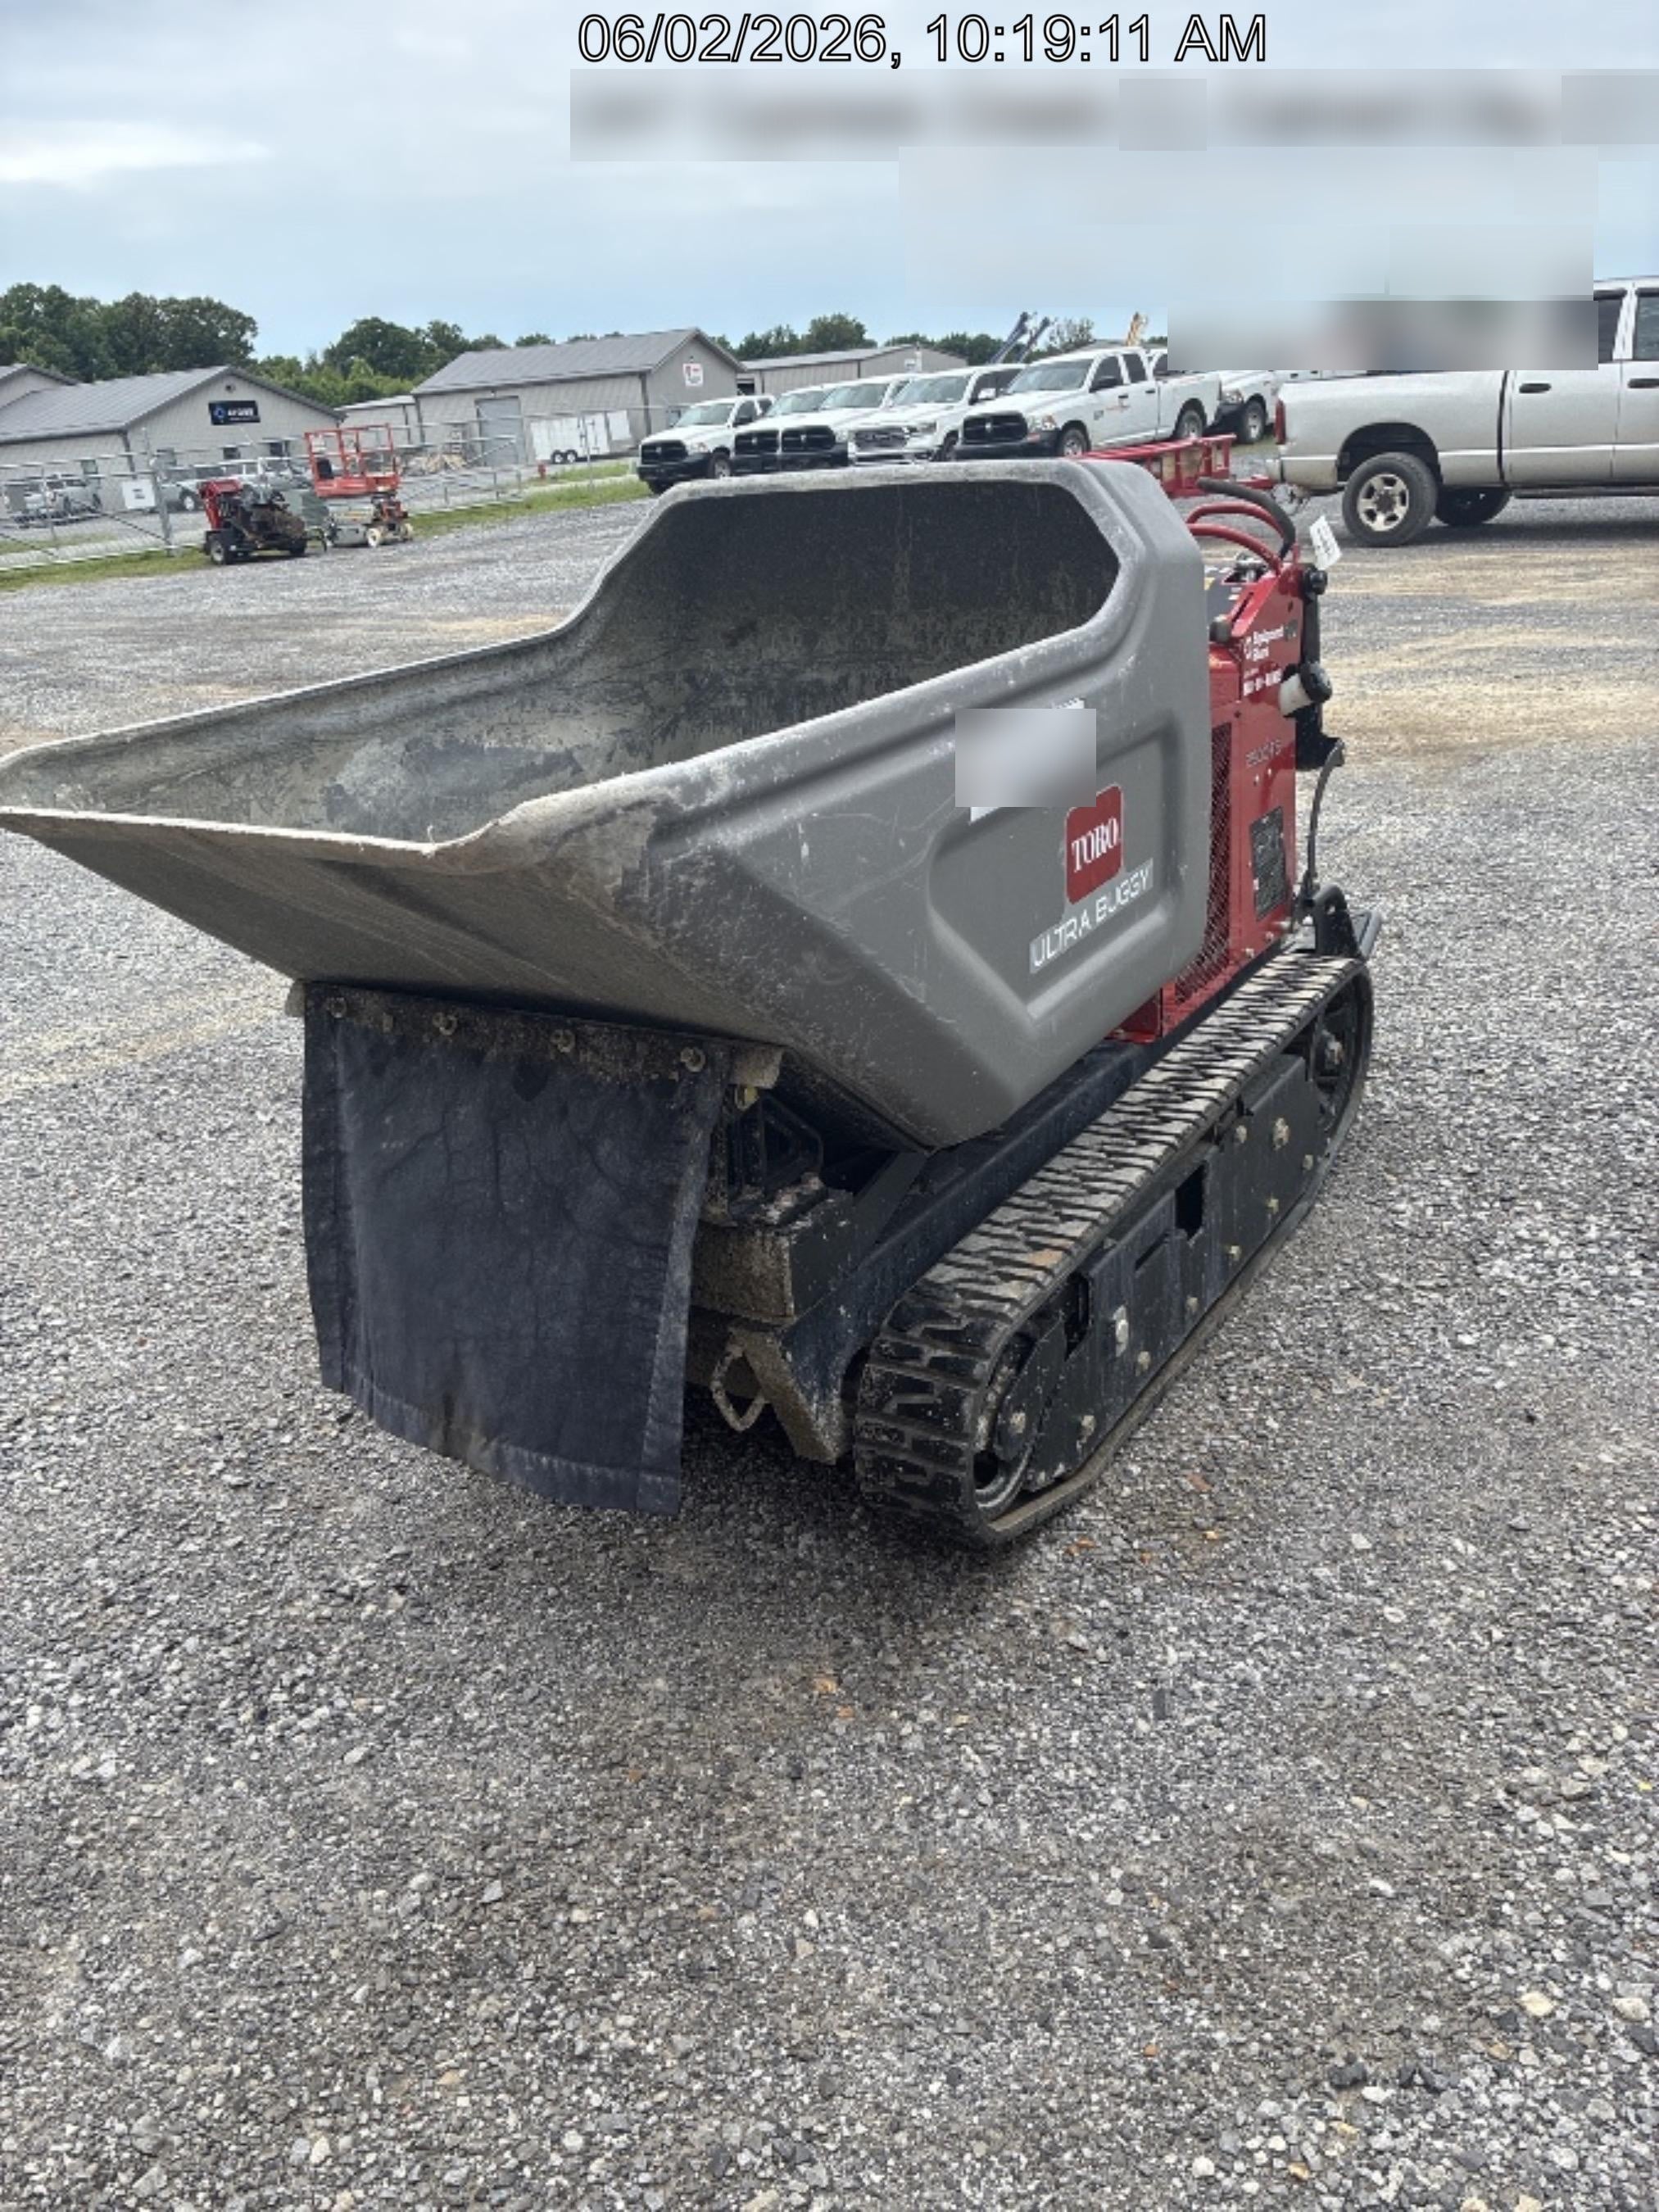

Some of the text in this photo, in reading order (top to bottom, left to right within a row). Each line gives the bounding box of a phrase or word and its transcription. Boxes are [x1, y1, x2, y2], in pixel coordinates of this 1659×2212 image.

[1072, 818, 1120, 873] TORO
[1033, 868, 1150, 967] ULTRA BUGGY
